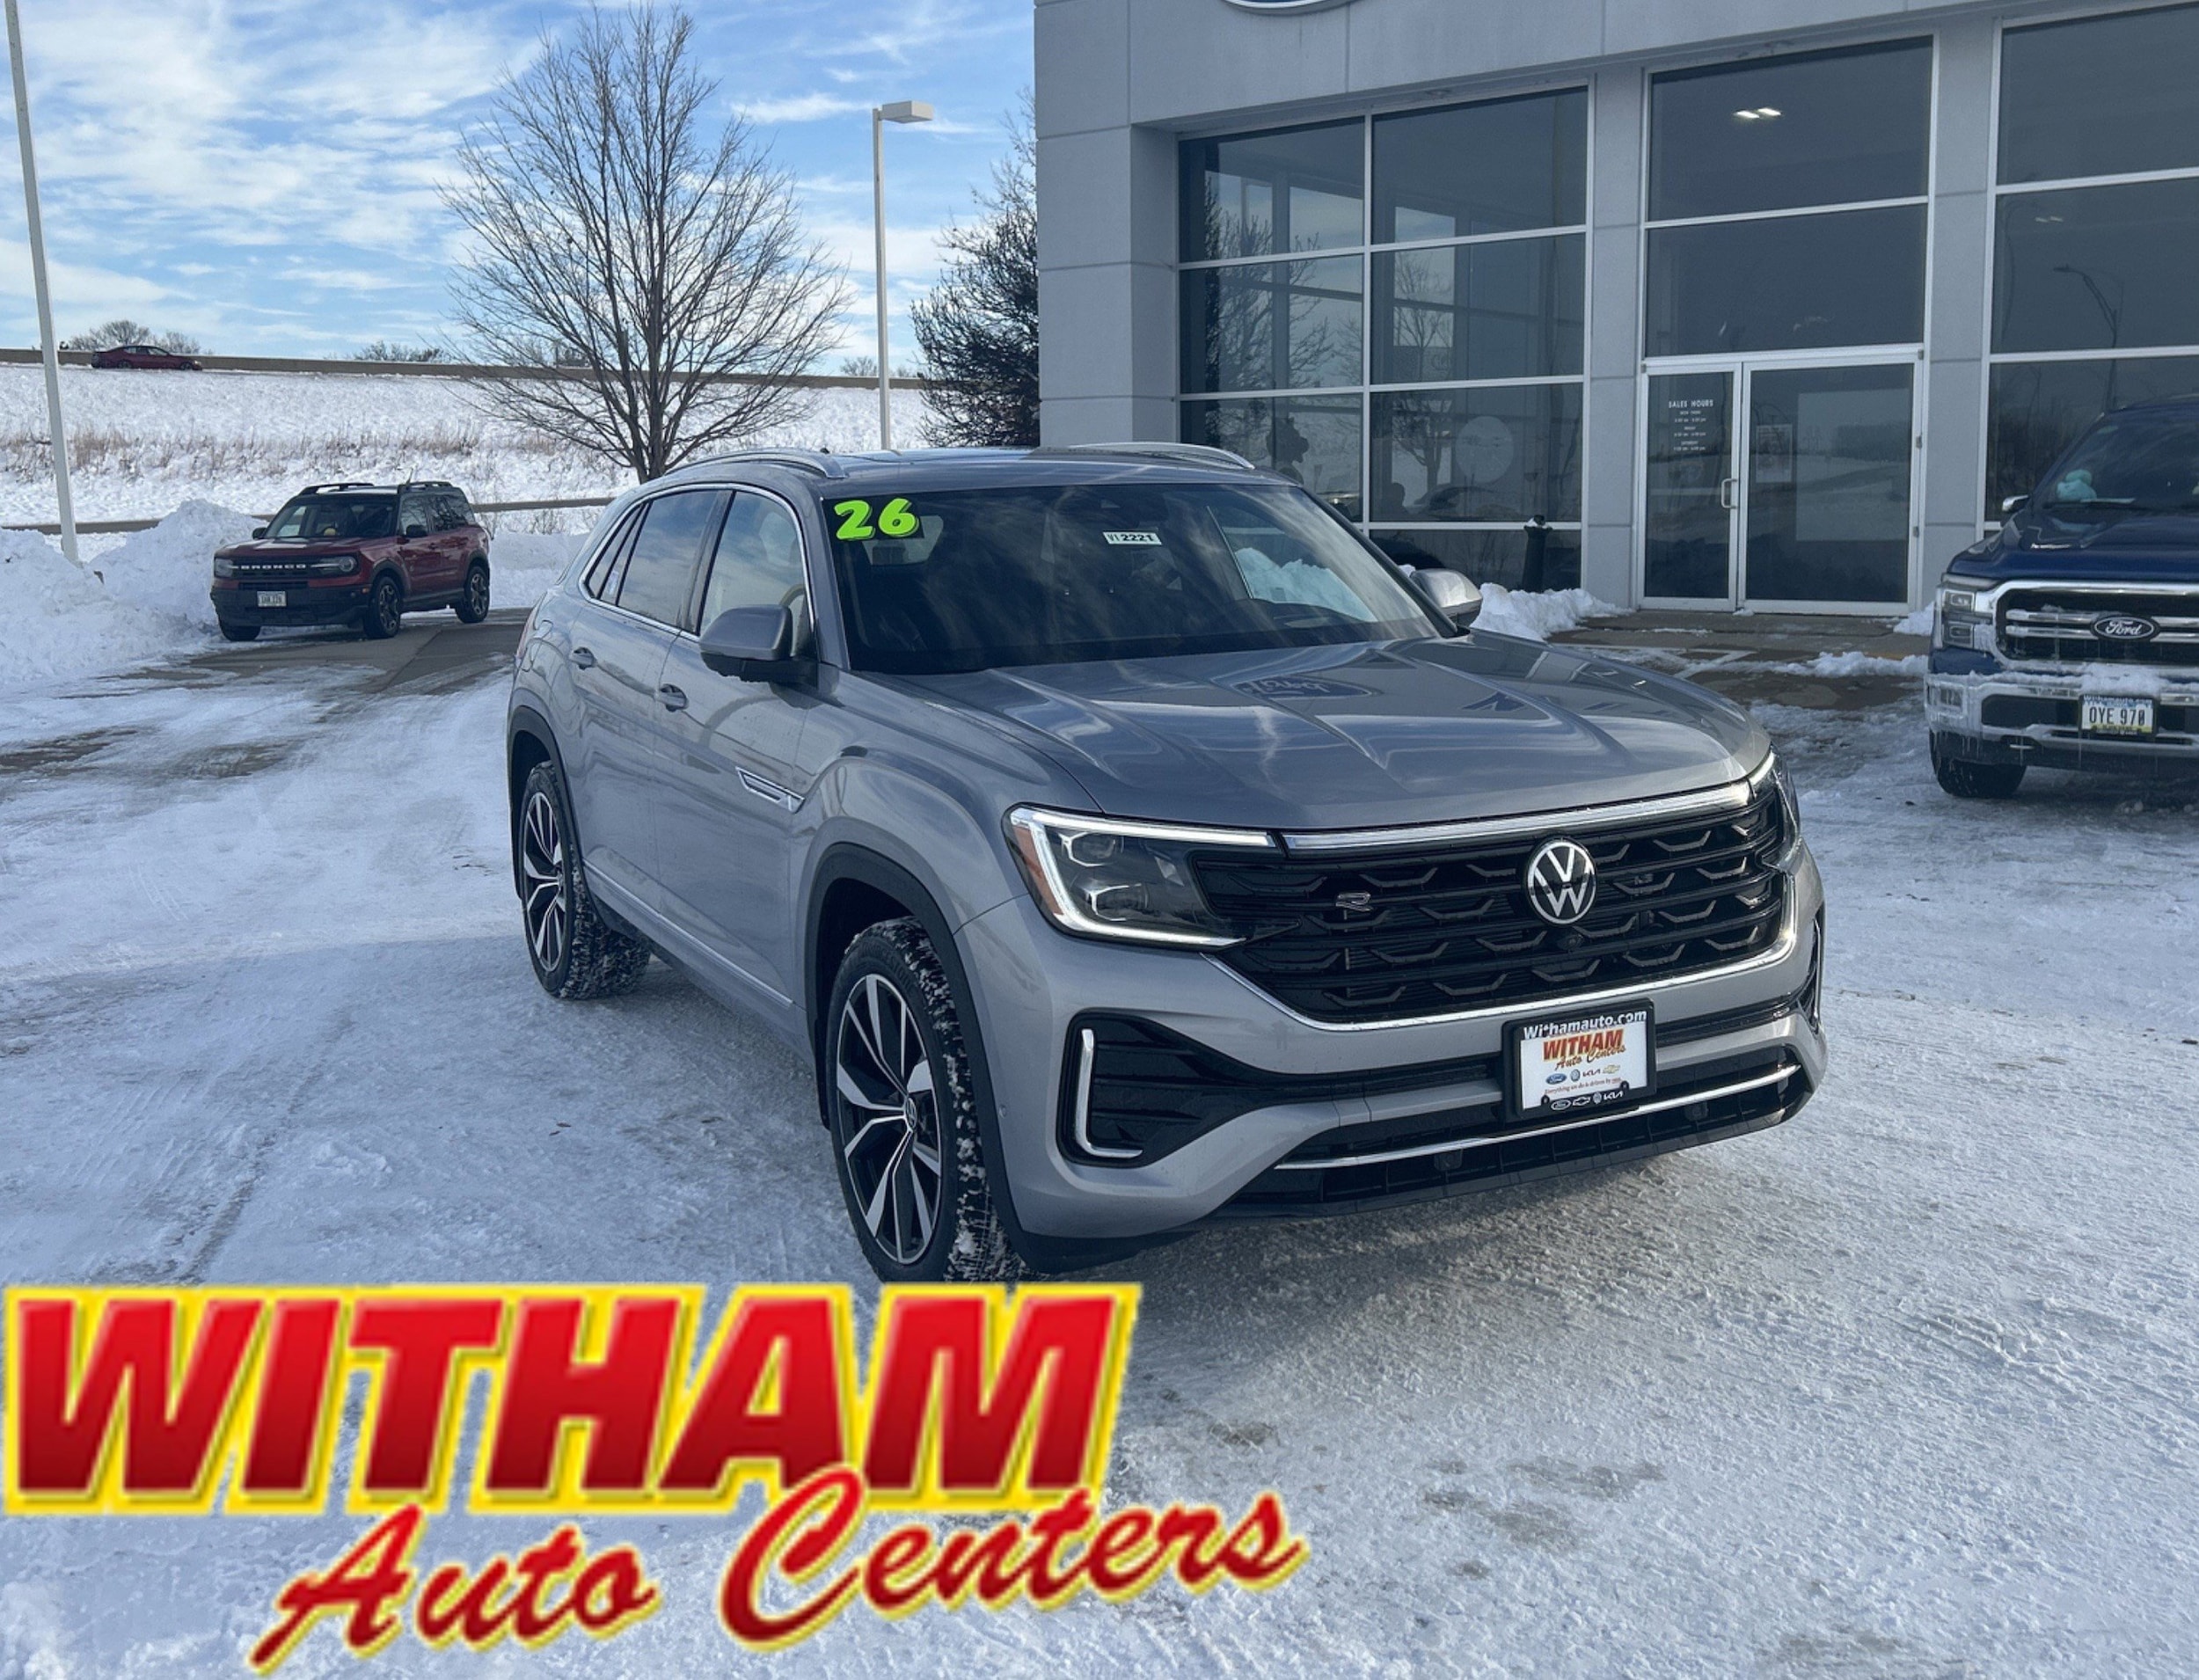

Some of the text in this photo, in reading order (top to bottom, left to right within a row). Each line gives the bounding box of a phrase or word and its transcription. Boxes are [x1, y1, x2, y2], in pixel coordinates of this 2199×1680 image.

[833, 498, 919, 540] 26
[2105, 619, 2143, 636] Ford
[1544, 1029, 1624, 1061] WITHAM
[1554, 1055, 1582, 1070] Auto
[1604, 1091, 1624, 1101] KIA
